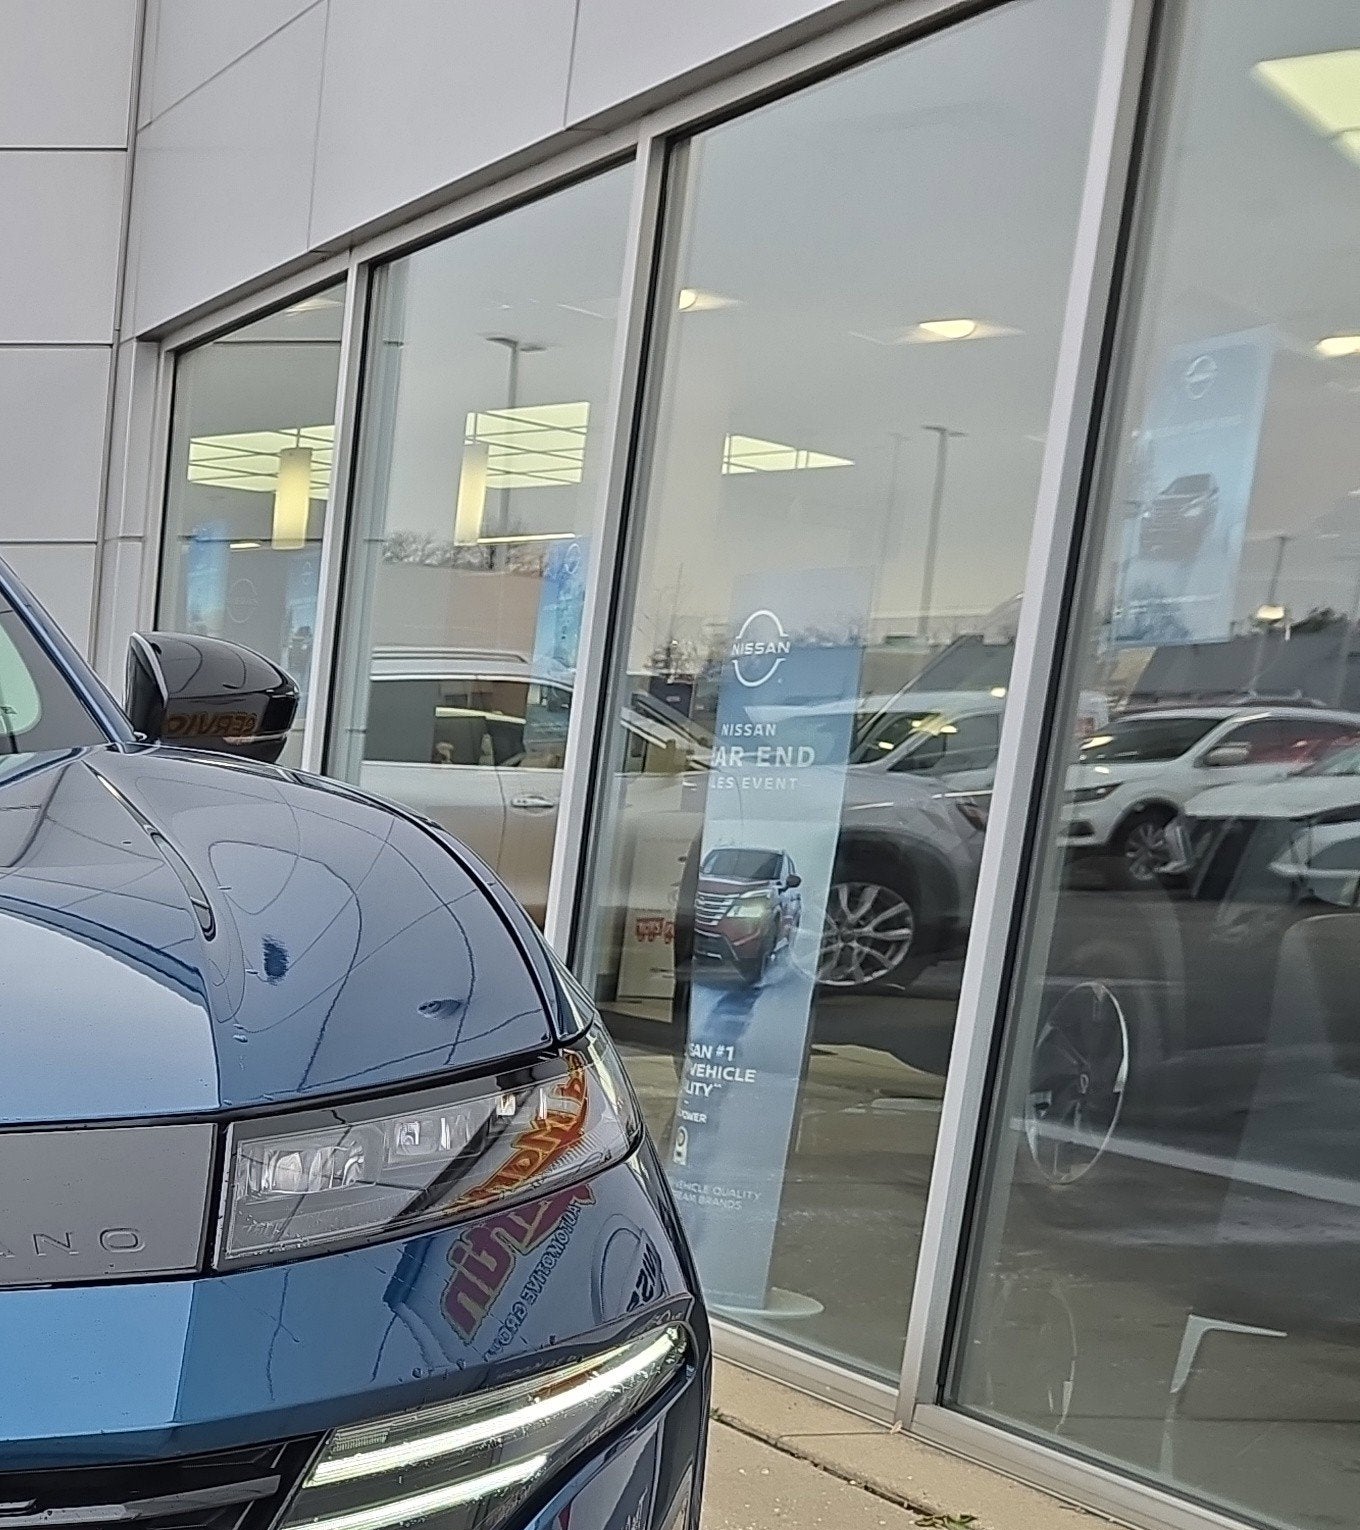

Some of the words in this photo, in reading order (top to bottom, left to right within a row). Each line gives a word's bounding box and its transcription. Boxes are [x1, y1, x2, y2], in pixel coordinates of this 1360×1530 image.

[731, 642, 791, 656] NISSAN
[721, 723, 777, 737] NISSAN
[711, 746, 745, 768] AR
[756, 746, 816, 768] END
[742, 777, 799, 790] EVENT
[688, 1043, 712, 1060] SAN
